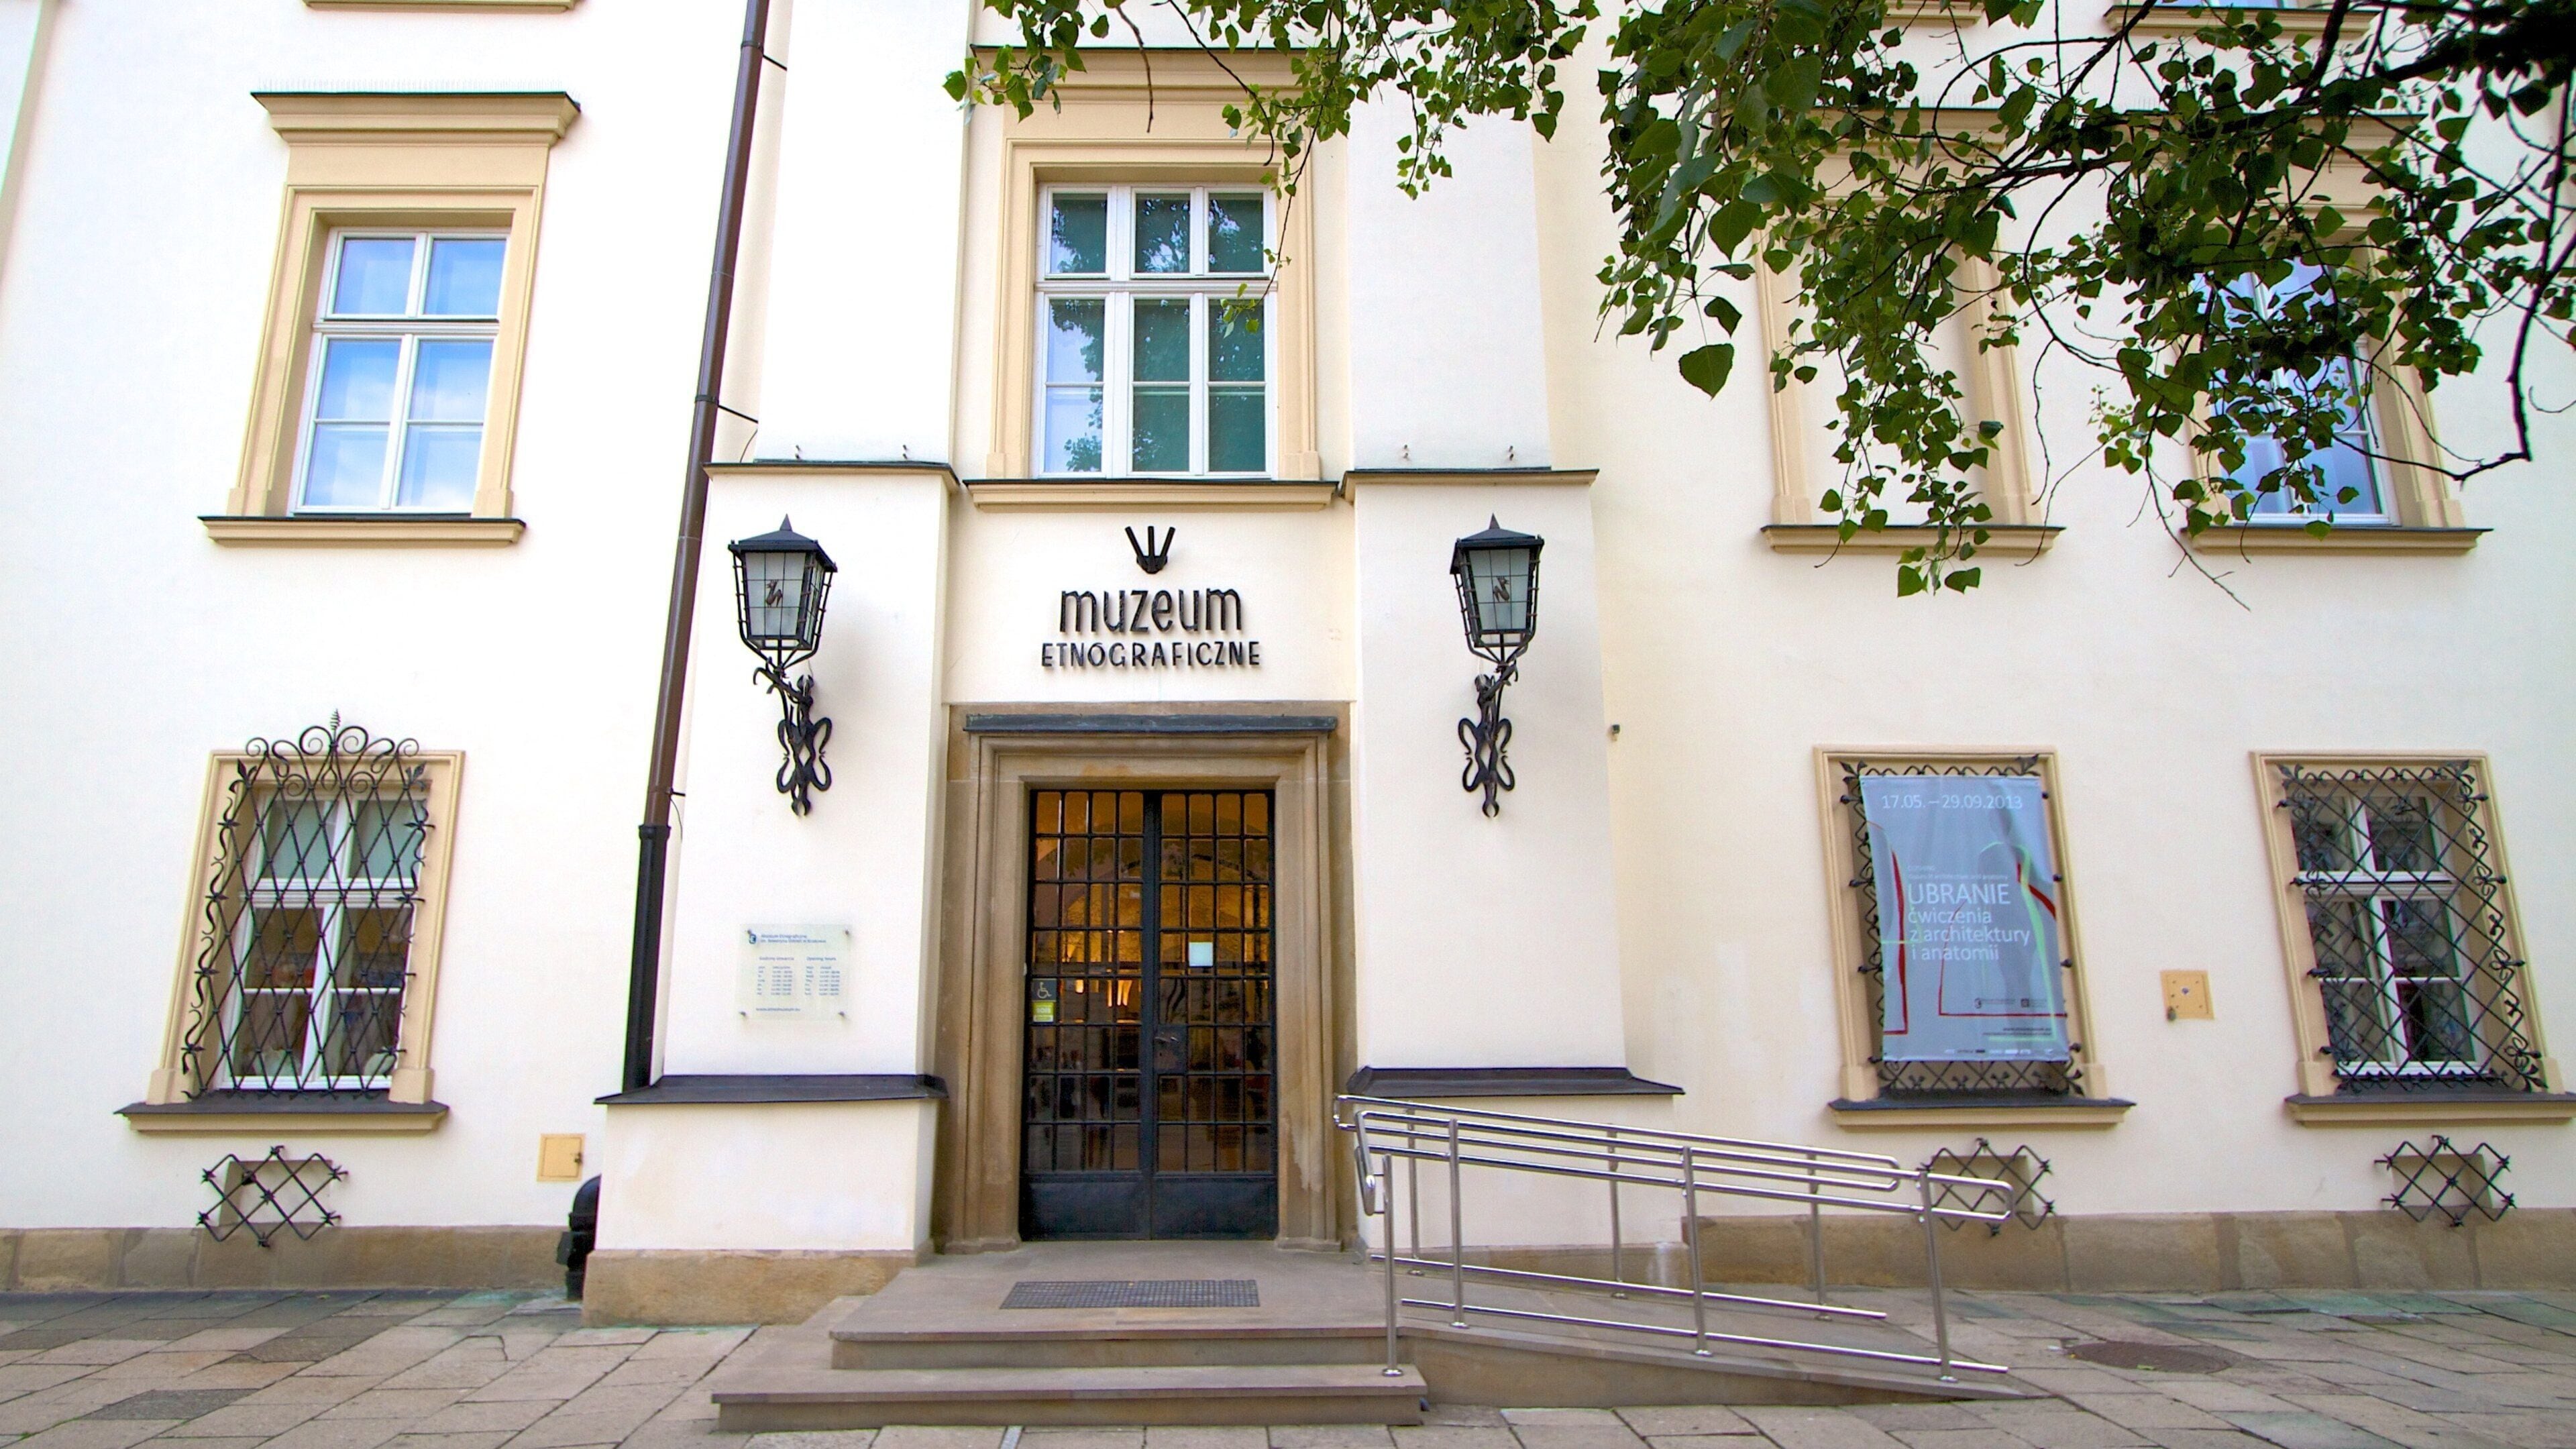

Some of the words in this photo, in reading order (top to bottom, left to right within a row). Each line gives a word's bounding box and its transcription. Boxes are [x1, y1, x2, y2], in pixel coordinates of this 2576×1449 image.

[1059, 588, 1243, 633] muzeum
[1041, 641, 1260, 667] ETNOGRAFICZNE
[1907, 883, 2011, 904] UBRANIE
[1907, 907, 1992, 924] ćwiczenia
[1909, 930, 1919, 942] z
[1923, 925, 2031, 947] architektury
[1912, 945, 1916, 960] i
[1921, 945, 2000, 961] anatomii
